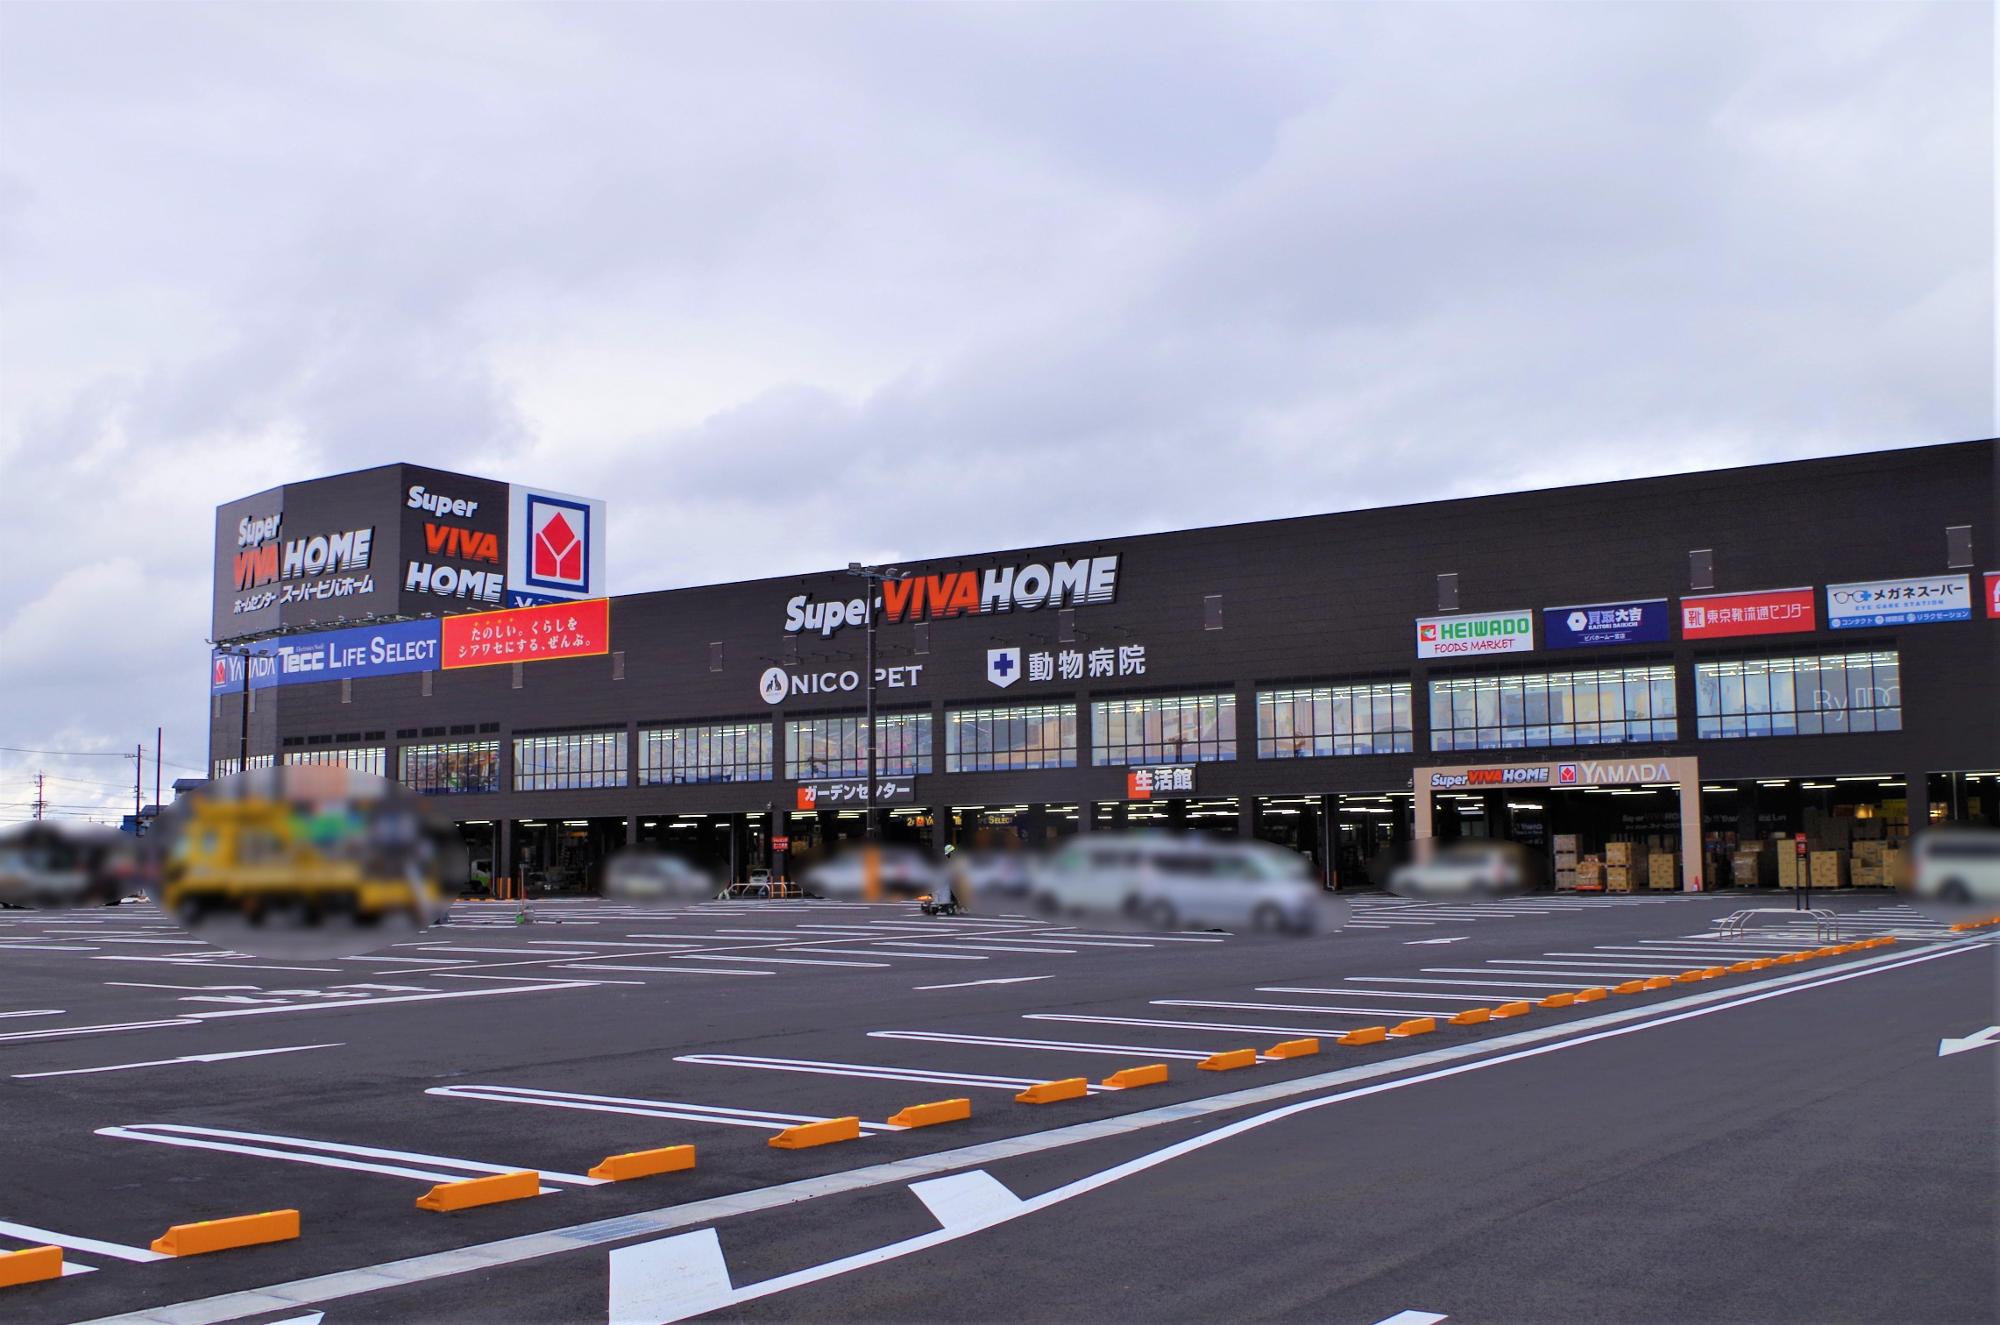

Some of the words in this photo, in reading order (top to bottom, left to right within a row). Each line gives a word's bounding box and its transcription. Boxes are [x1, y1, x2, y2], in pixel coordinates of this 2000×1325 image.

[407, 485, 478, 518] Super
[237, 513, 281, 548] Super
[425, 523, 499, 564] VIVA
[233, 544, 280, 590] VIVA
[281, 527, 373, 578] HOME
[405, 561, 504, 603] HOME
[1873, 583, 1964, 601] メガネスーパー
[1707, 603, 1811, 624] 東京靴流通センター
[1441, 618, 1529, 640] HEIWADO
[329, 643, 366, 668] LIFE
[370, 636, 437, 664] SELECT
[1434, 642, 1468, 654] FOODS
[1471, 638, 1516, 652] MARKET
[1028, 644, 1146, 682] 動物病院
[791, 670, 859, 696] NICO
[1135, 768, 1193, 791] 生活館
[1431, 773, 1468, 788] Super
[1580, 762, 1671, 783] YAMADA
